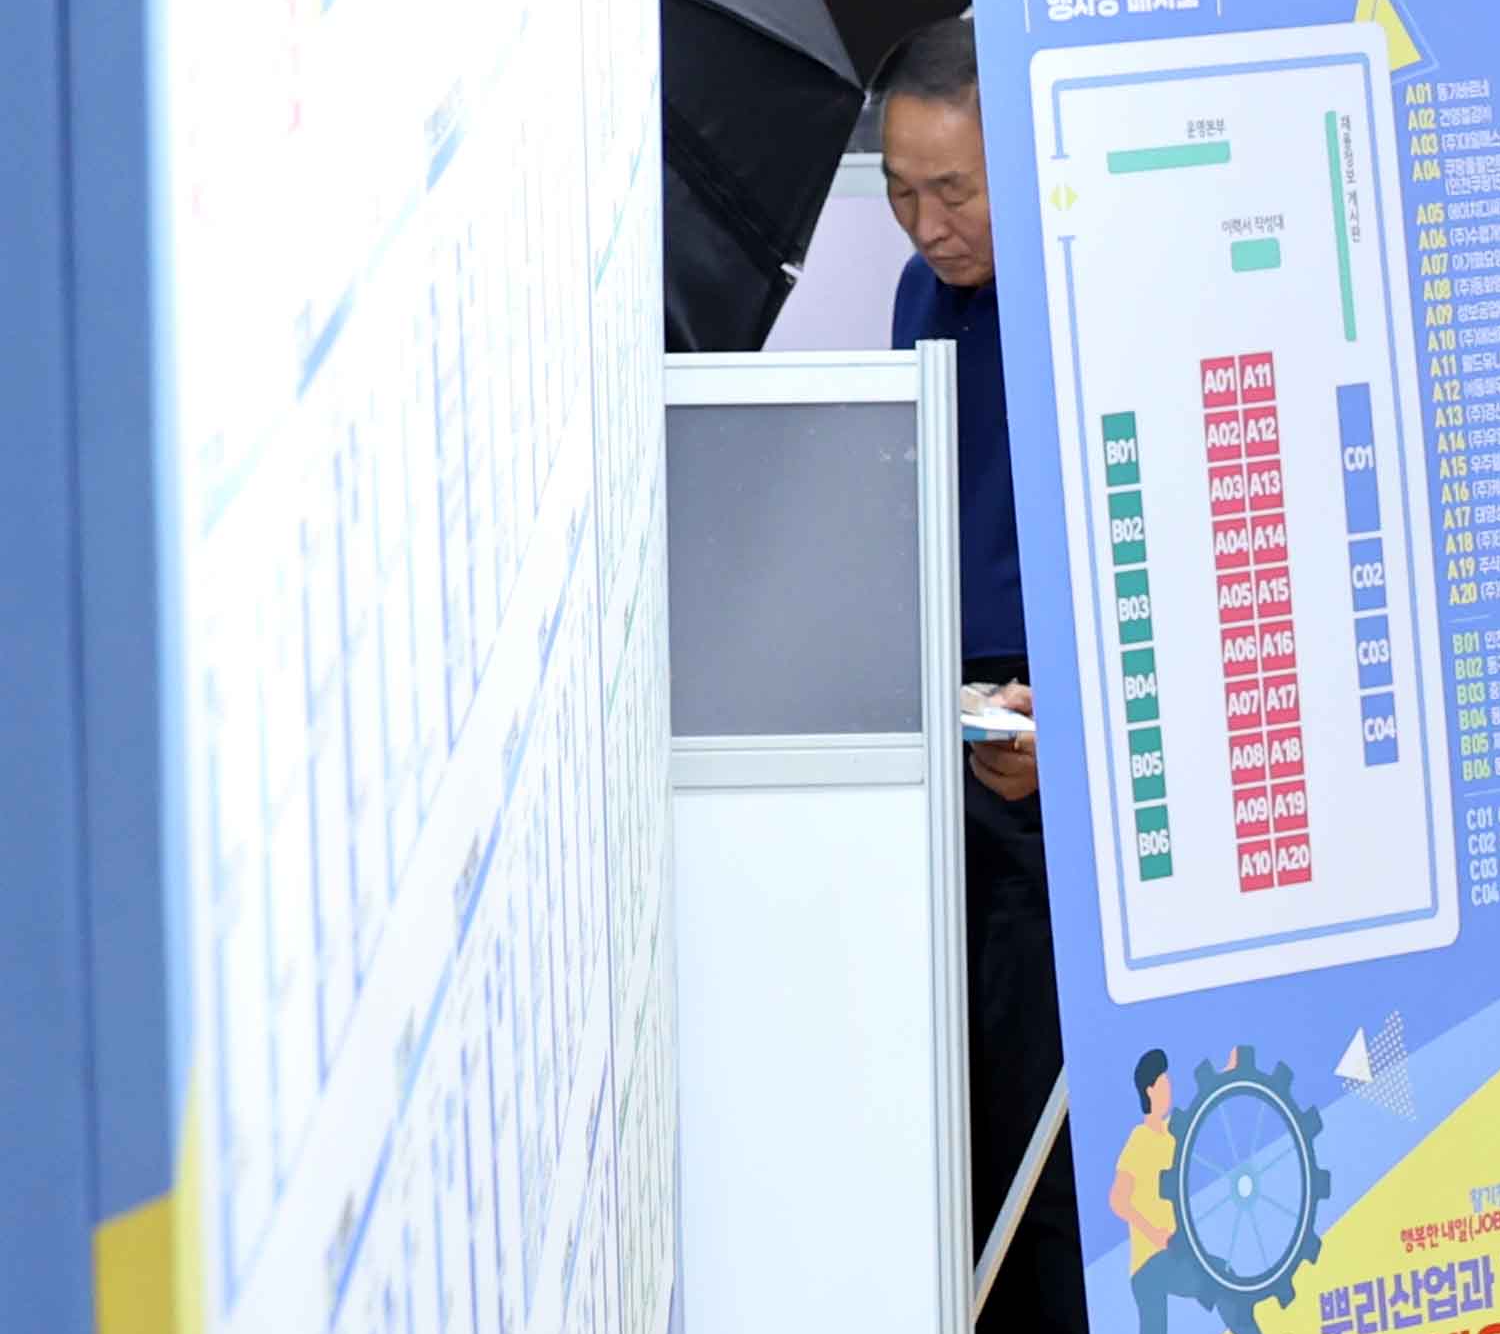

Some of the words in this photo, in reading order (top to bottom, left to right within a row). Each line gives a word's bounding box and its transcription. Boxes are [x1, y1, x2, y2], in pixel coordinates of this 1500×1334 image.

[1406, 83, 1432, 105] A01
[1408, 108, 1436, 131] A02
[1411, 133, 1438, 155] A03
[1413, 159, 1440, 181] A04
[1417, 203, 1444, 225] A05
[1419, 229, 1446, 251] A06
[1421, 253, 1448, 275] A07
[1424, 278, 1451, 301] A08
[1425, 304, 1452, 327] A09
[1428, 330, 1456, 352] A10
[1430, 355, 1457, 377] A11
[1203, 372, 1236, 392] A01
[1242, 367, 1273, 388] A11
[1433, 381, 1461, 403] A12
[1435, 406, 1463, 428] A13
[1207, 426, 1240, 446] A02
[1246, 420, 1277, 441] A12
[1106, 440, 1137, 464] B01
[1438, 431, 1465, 454] A14
[1343, 447, 1373, 469] C01
[1440, 457, 1467, 479] A15
[1211, 479, 1244, 500] A03
[1250, 473, 1281, 495] A13
[1442, 482, 1469, 504] A16
[1444, 507, 1471, 529] A17
[1112, 519, 1143, 542] B02
[1254, 527, 1285, 548] A14
[1215, 533, 1248, 554] A04
[1446, 532, 1473, 554] A18
[1352, 563, 1383, 586] C02
[1448, 558, 1475, 580] A19
[1219, 587, 1252, 607] A05
[1258, 580, 1289, 602] A15
[1450, 583, 1477, 605] A20
[1119, 597, 1150, 620] B03
[1223, 640, 1256, 661] A06
[1261, 633, 1293, 655] A16
[1358, 638, 1389, 663] C03
[1453, 632, 1479, 655] B01
[1455, 657, 1483, 680] B02
[1126, 675, 1157, 699] B04
[1265, 687, 1297, 709] A17
[1457, 682, 1485, 705] B03
[1228, 694, 1260, 715] A07
[1364, 716, 1395, 740] C04
[1459, 708, 1487, 731] B04
[1269, 740, 1302, 762] A18
[1461, 733, 1489, 756] B05
[1132, 753, 1163, 777] B05
[1232, 748, 1264, 769] A08
[1463, 758, 1491, 782] B06
[1236, 801, 1268, 822] A09
[1273, 794, 1306, 815] A19
[1467, 806, 1493, 830] C01
[1139, 831, 1170, 855] B06
[1468, 832, 1496, 855] C02
[1240, 855, 1272, 876] A10
[1277, 847, 1310, 869] A20
[1470, 857, 1498, 881] C03
[1472, 882, 1500, 906] C04
